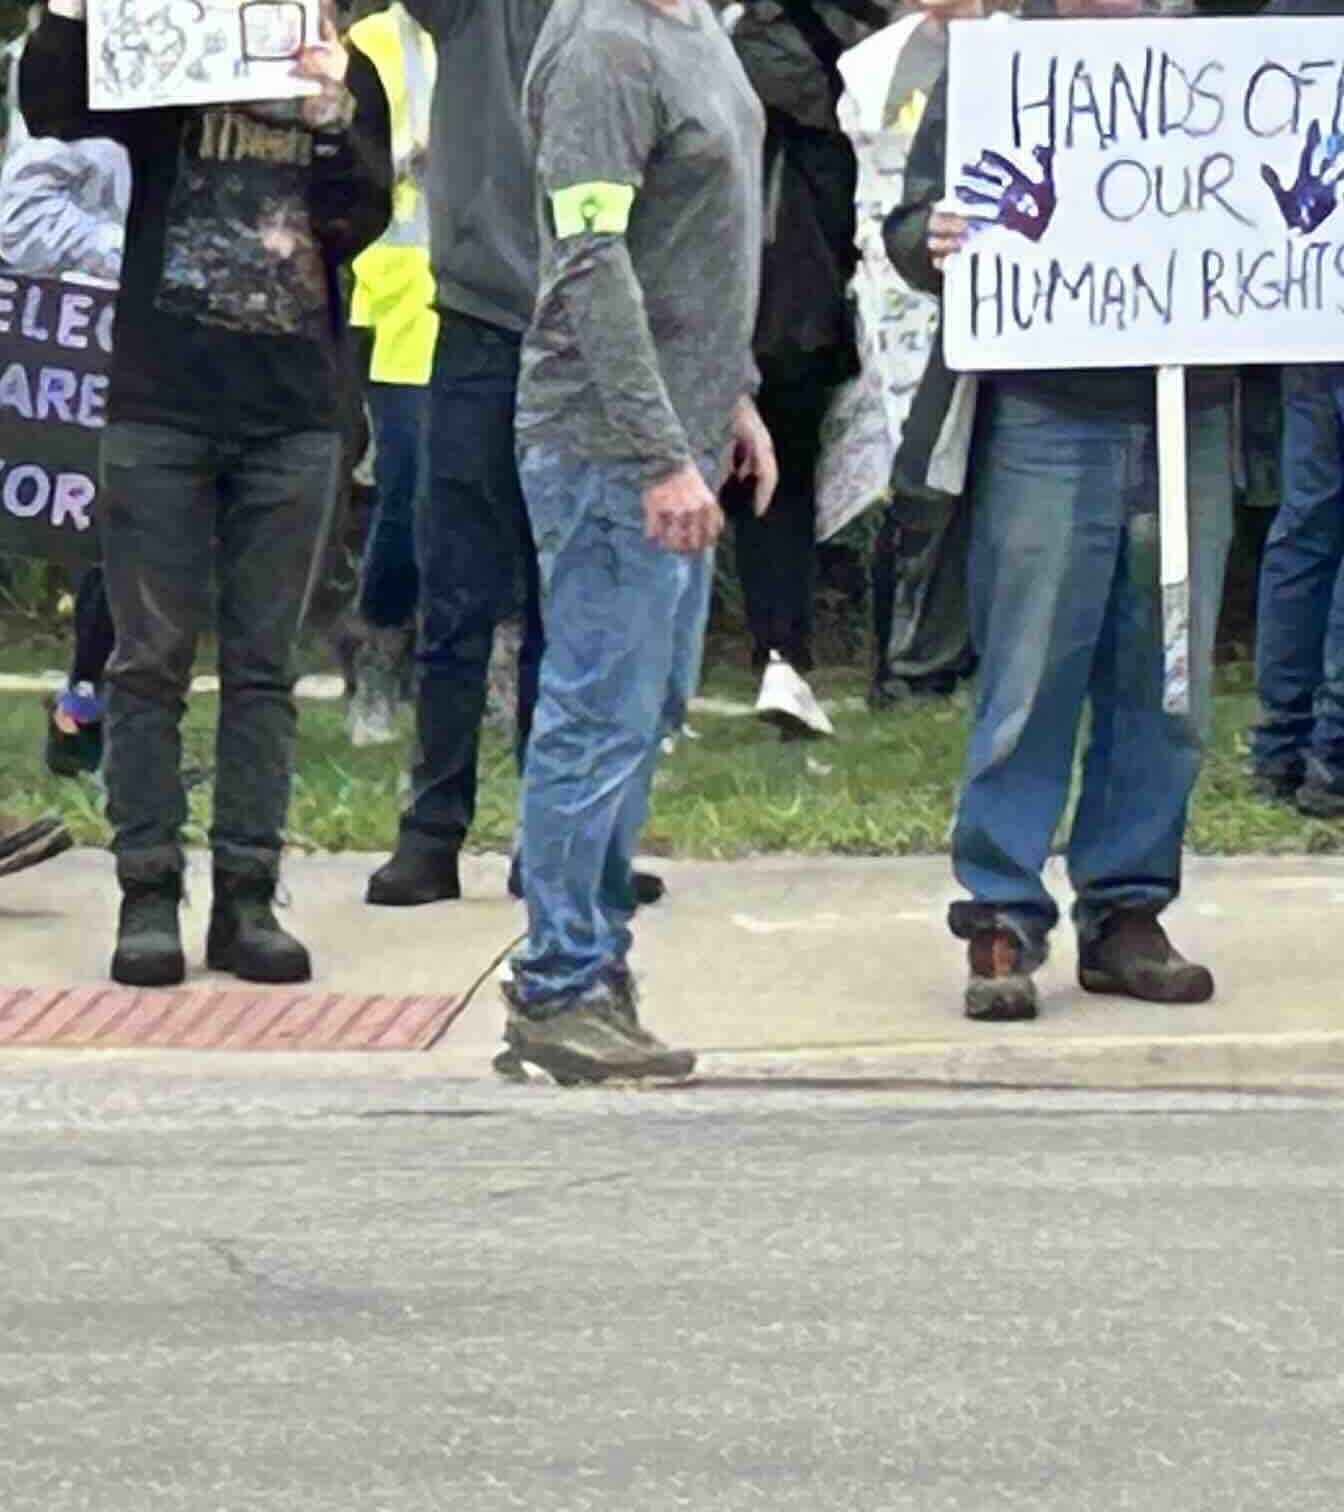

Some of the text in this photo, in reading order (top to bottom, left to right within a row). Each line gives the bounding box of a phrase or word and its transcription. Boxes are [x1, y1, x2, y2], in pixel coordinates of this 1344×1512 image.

[1011, 46, 1226, 150] HANDS
[1096, 151, 1256, 227] OUR
[969, 248, 1177, 338] HUMAN
